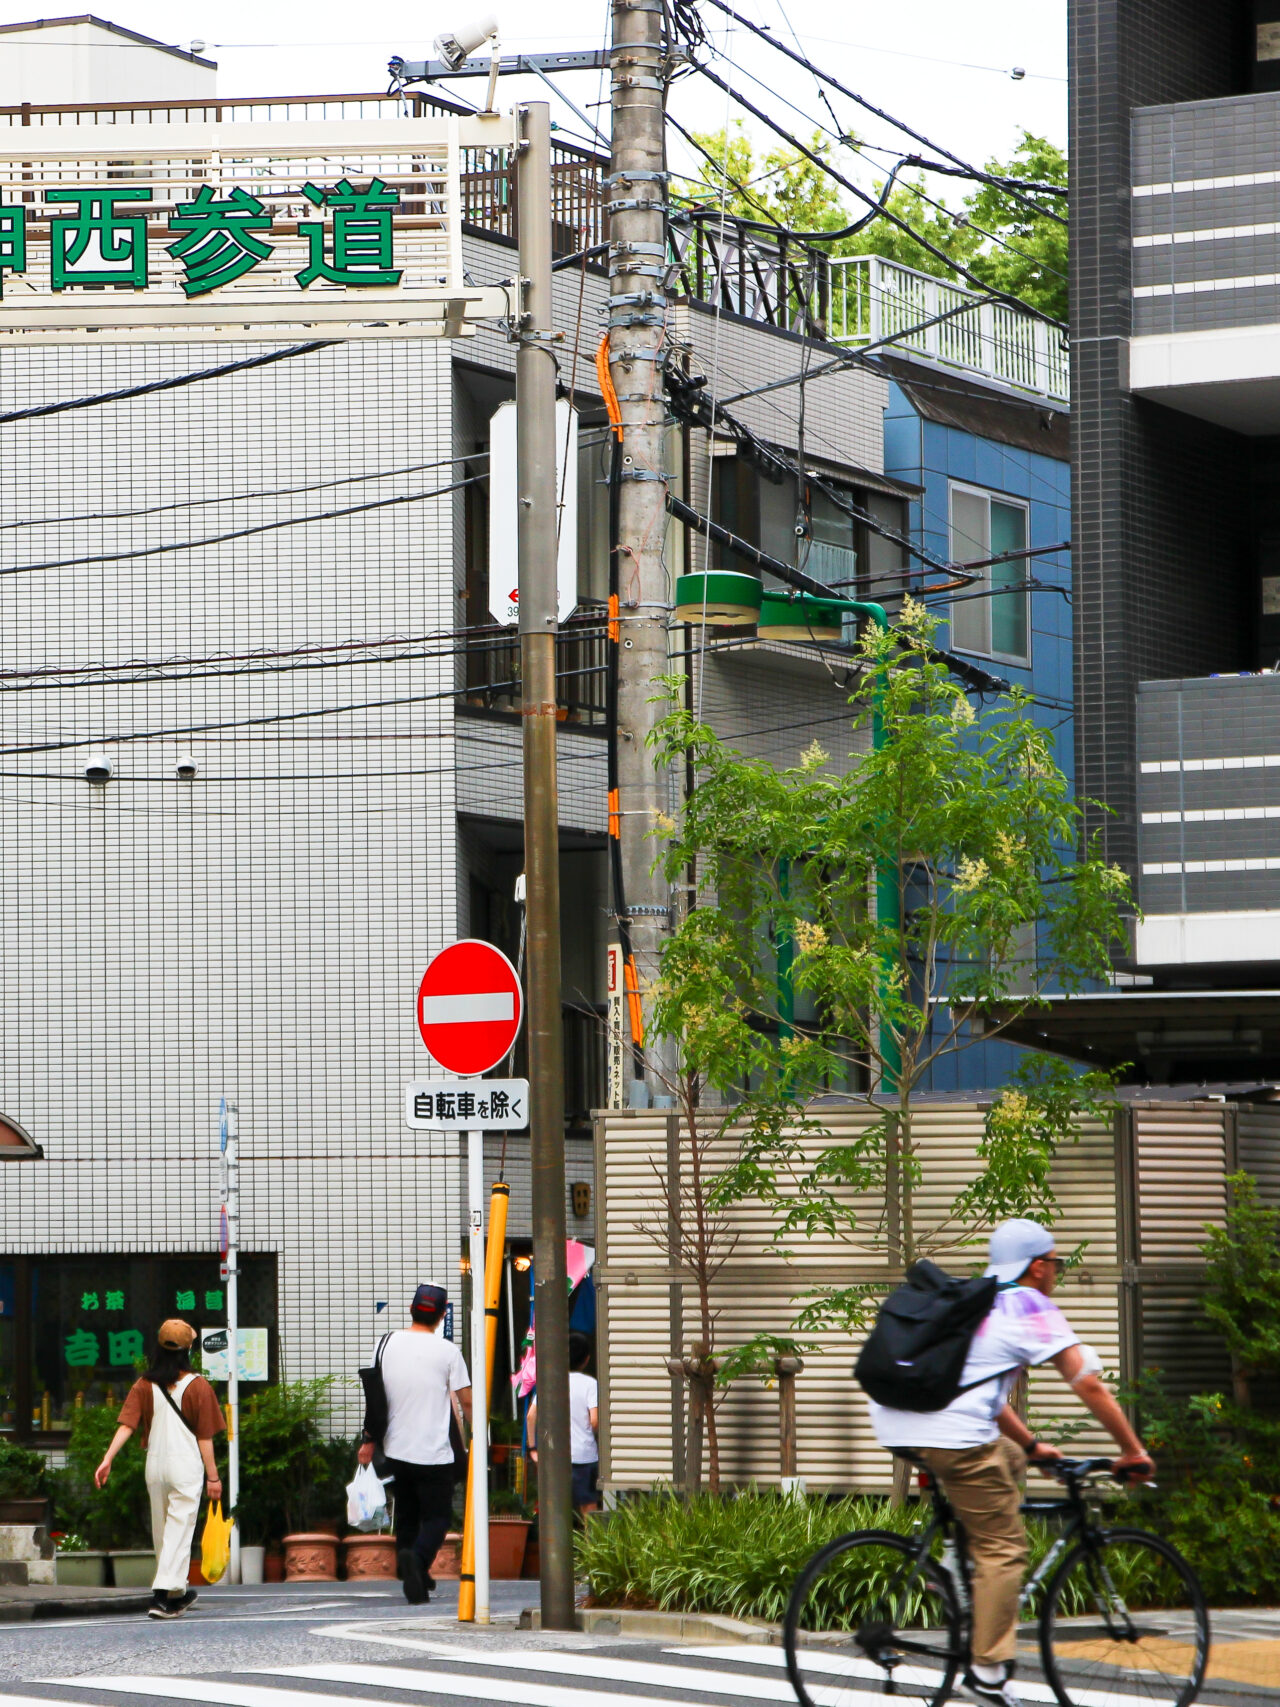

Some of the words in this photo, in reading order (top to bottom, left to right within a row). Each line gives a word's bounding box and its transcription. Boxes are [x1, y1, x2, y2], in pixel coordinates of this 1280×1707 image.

[413, 1090, 523, 1121] 自転車を除く
[81, 1290, 125, 1311] お茶
[63, 1327, 145, 1367] 吉田
